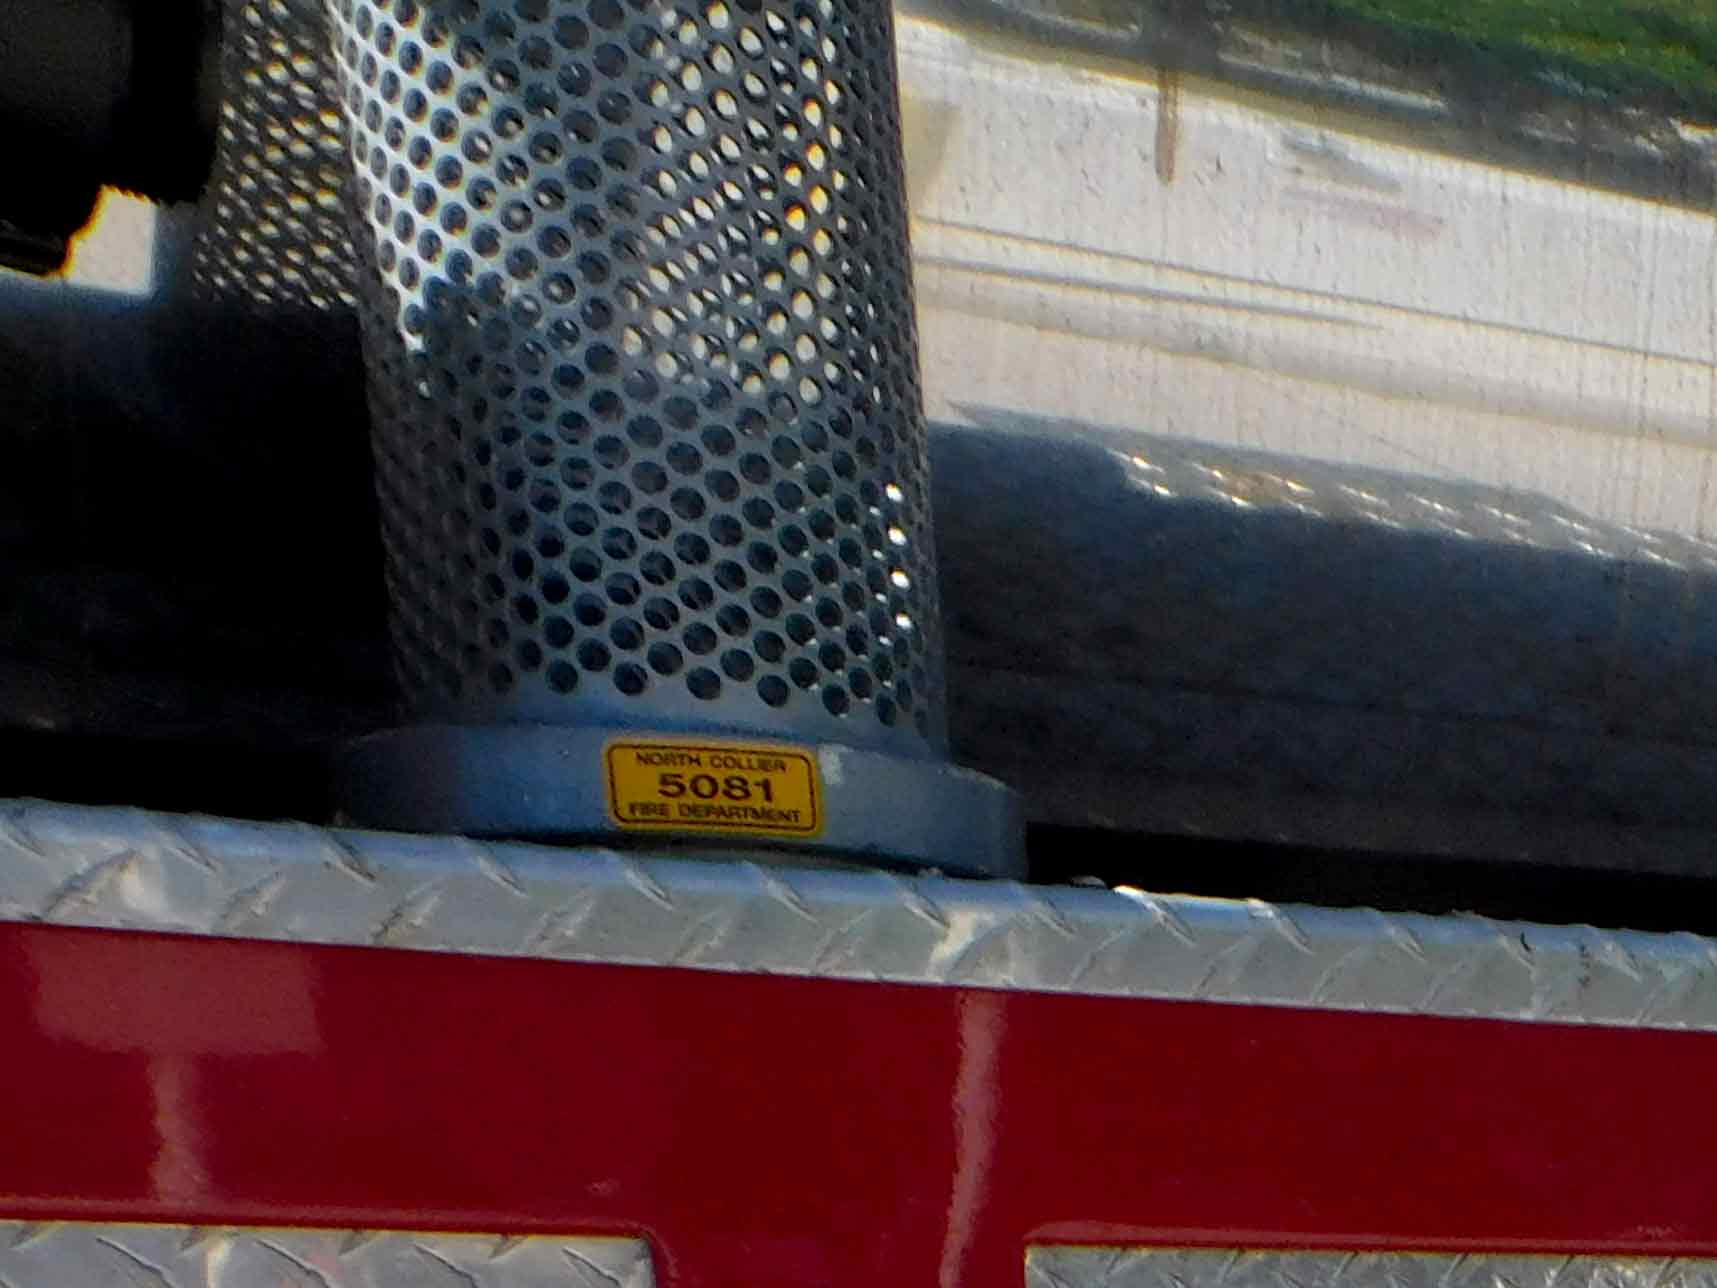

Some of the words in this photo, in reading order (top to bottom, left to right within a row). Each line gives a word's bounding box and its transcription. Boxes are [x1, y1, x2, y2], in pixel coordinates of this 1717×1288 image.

[636, 751, 702, 767] NORTH
[710, 755, 786, 773] COLLIER
[658, 774, 772, 803] 5081
[629, 801, 671, 816] FIRE
[679, 803, 801, 823] DEPARTMENT
